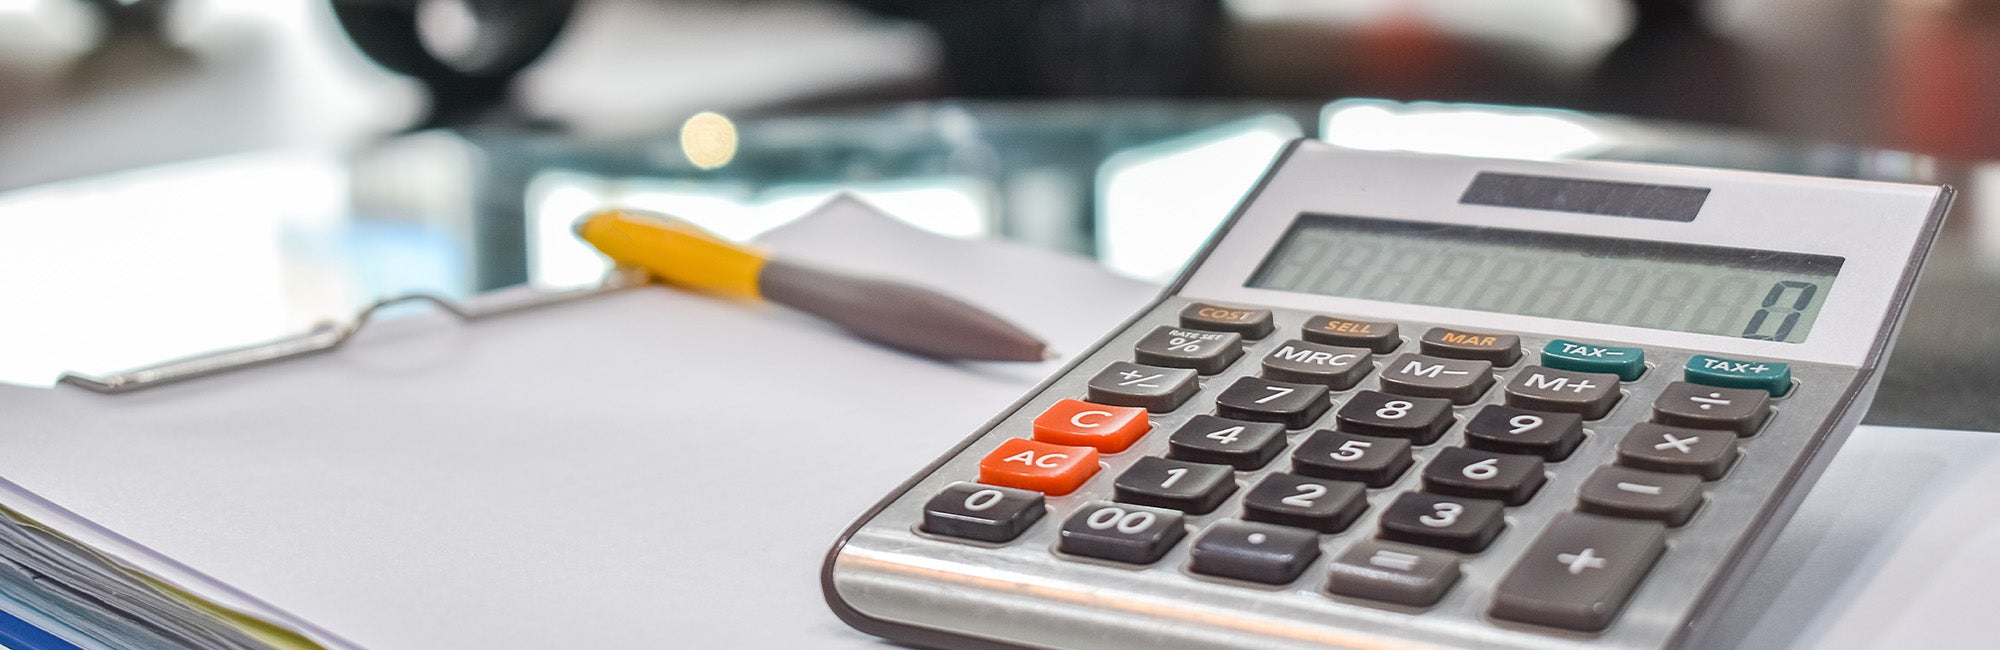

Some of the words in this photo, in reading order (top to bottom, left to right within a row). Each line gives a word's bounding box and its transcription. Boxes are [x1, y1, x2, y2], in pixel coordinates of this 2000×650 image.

[1198, 307, 1252, 322] COST
[1169, 329, 1198, 338] RATE
[1202, 333, 1222, 341] SET
[1325, 320, 1371, 334] SELL
[1169, 337, 1199, 352] %
[1441, 332, 1496, 347] MAR
[1273, 345, 1358, 367] MRC
[1704, 357, 1769, 374] TAX+
[1523, 374, 1596, 393] M+
[1254, 386, 1294, 404] 7
[1070, 410, 1112, 428] C
[1375, 400, 1413, 420] 8
[1509, 415, 1543, 435] 9
[1206, 426, 1246, 445] 4
[1003, 450, 1069, 468] AC
[1329, 440, 1372, 462] 5
[1159, 468, 1188, 489] 1
[1462, 458, 1499, 481] 6
[963, 489, 1004, 512] 0
[1281, 483, 1328, 508] 2
[1087, 507, 1156, 534] 00
[1419, 502, 1464, 528] 3
